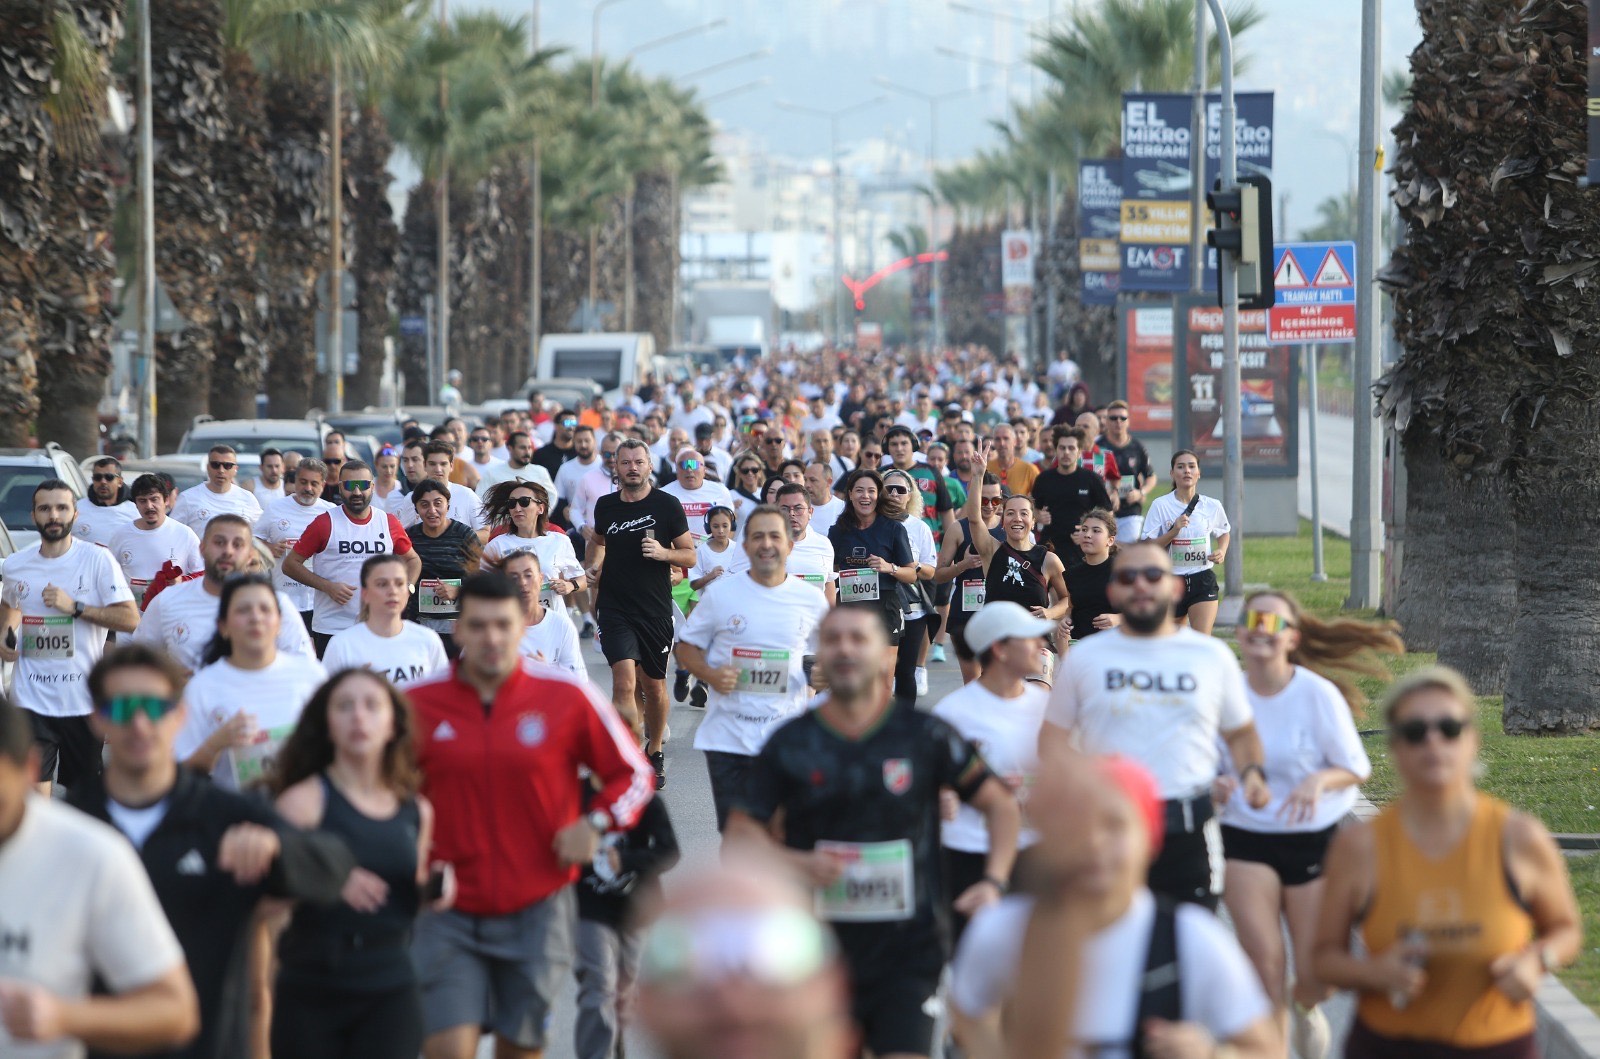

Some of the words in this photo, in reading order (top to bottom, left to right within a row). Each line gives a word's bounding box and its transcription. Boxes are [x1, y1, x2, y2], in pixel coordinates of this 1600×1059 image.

[1127, 101, 1166, 126] EL
[1127, 206, 1148, 220] 35
[1282, 290, 1318, 302] TRAMVAY
[1320, 289, 1343, 301] HATTI
[1301, 305, 1322, 316] HAT
[338, 540, 386, 554] BOLD
[1172, 551, 1206, 561] 350563
[841, 582, 878, 595] 350604
[23, 635, 70, 650] 350105
[62, 673, 82, 682] KEY
[1105, 668, 1197, 692] BOLD
